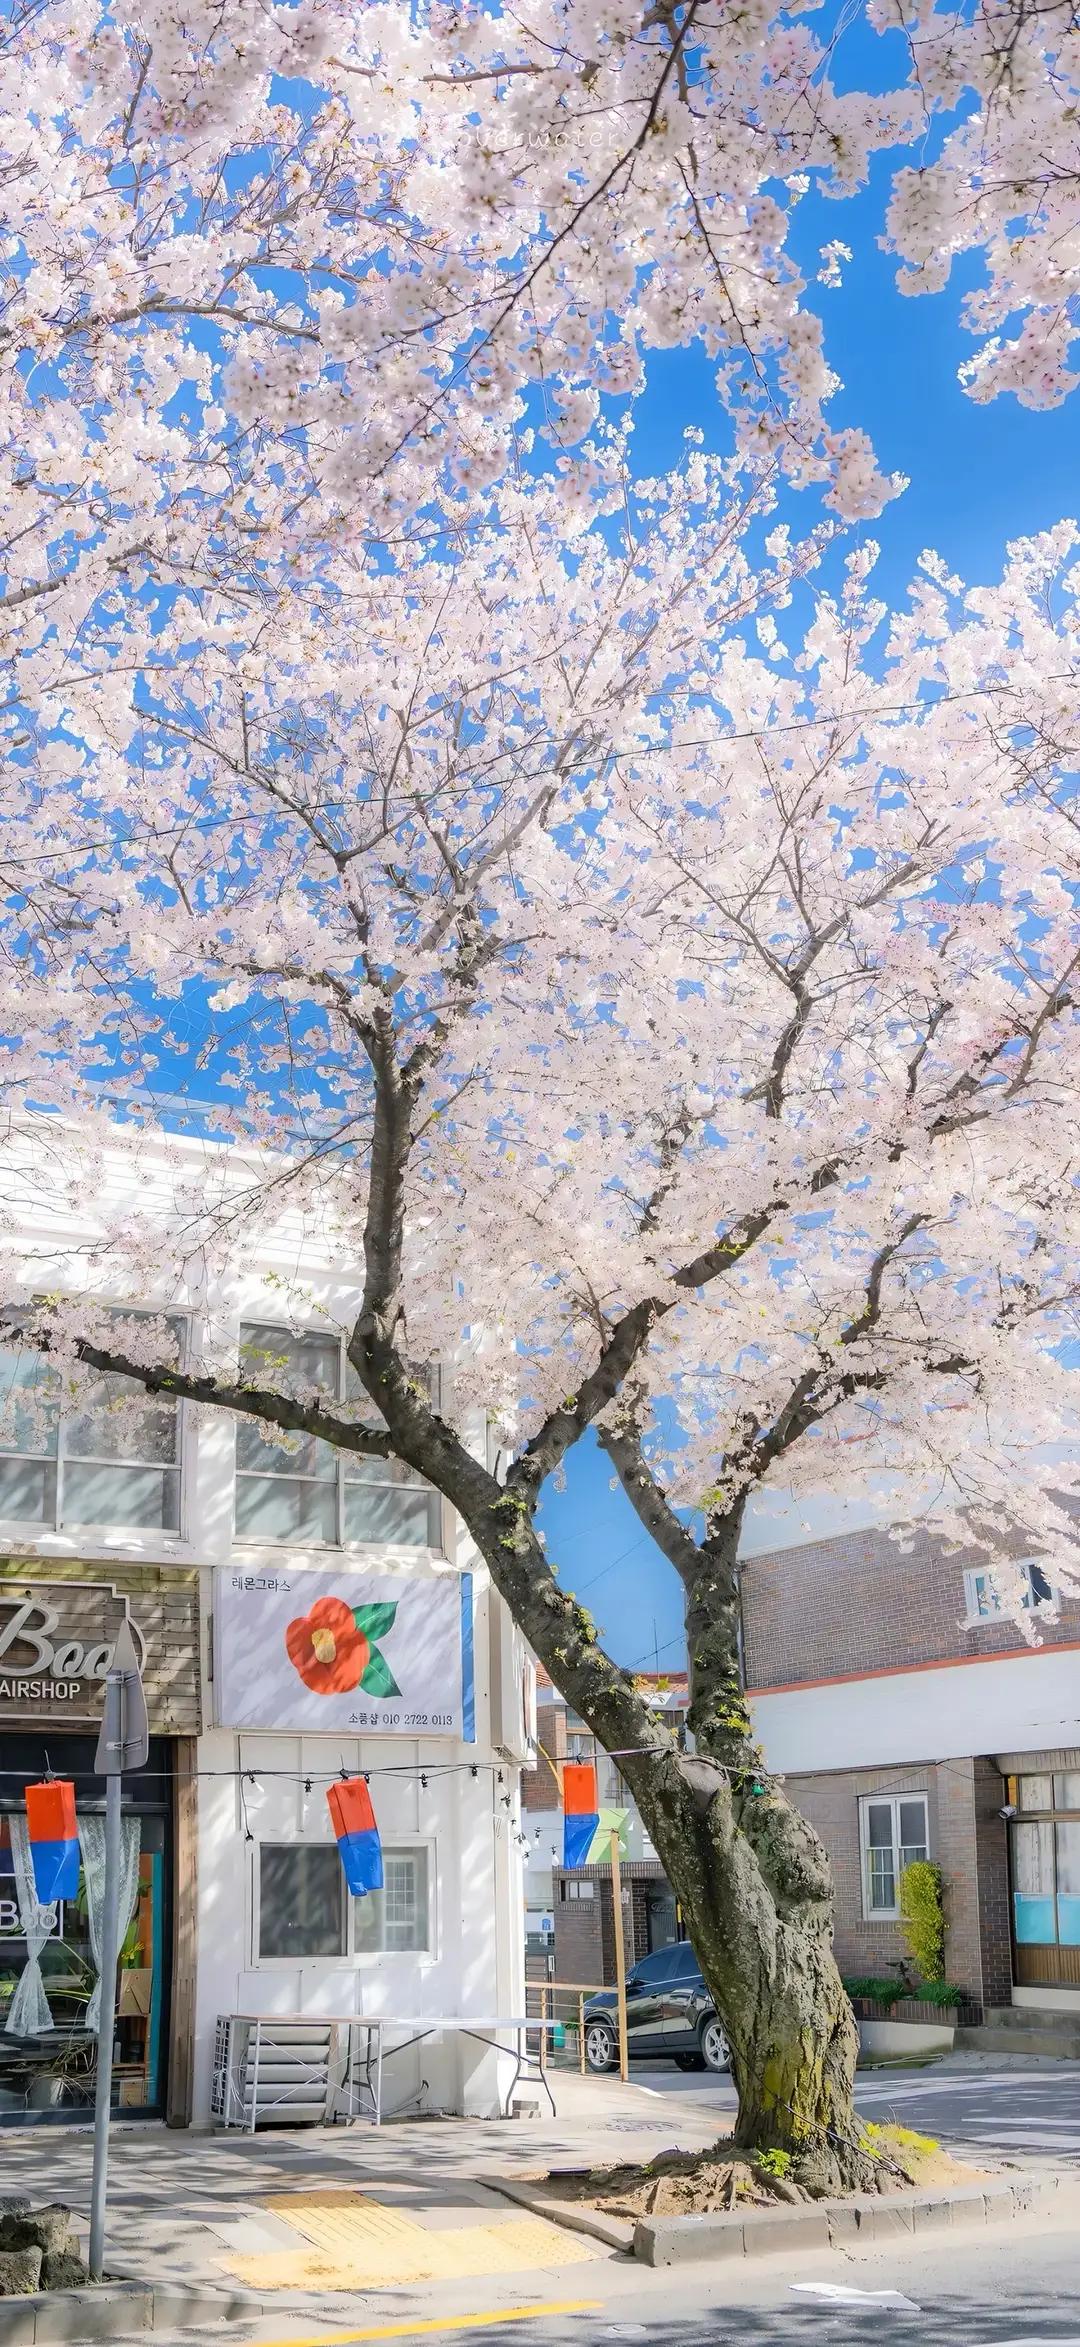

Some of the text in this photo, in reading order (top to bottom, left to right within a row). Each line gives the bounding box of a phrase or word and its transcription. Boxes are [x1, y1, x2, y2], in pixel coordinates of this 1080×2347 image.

[231, 1576, 292, 1592] 레몬그라스
[382, 1713, 400, 1725] 010
[404, 1714, 428, 1725] 2722
[431, 1714, 453, 1726] 0113
